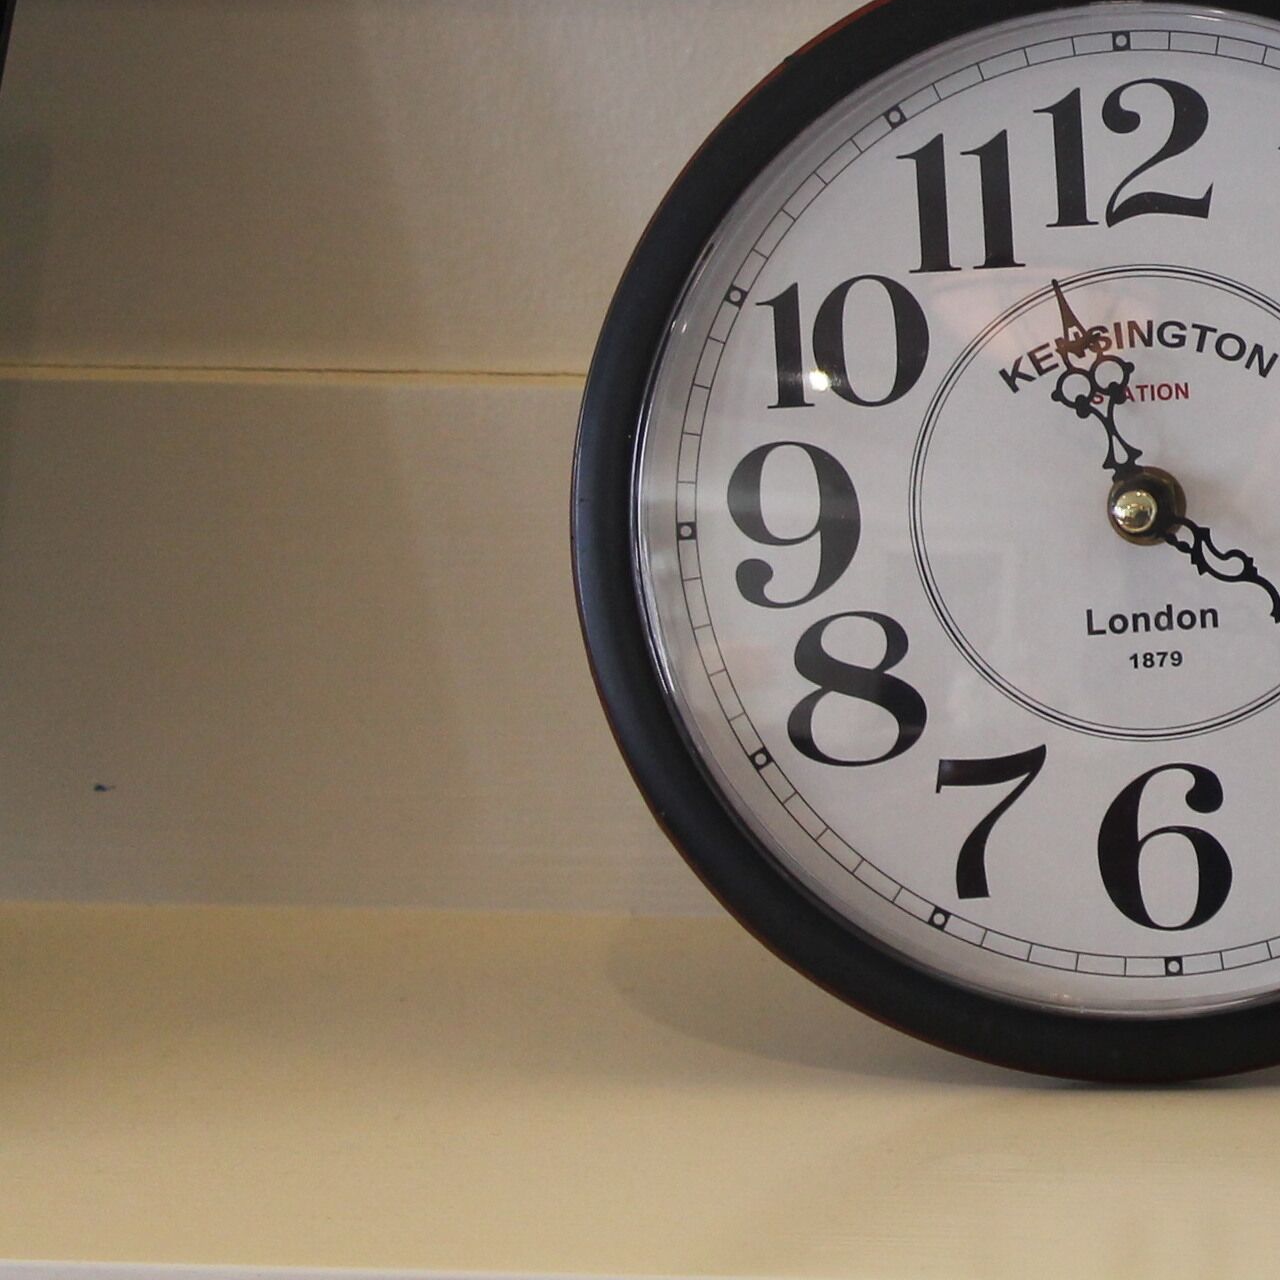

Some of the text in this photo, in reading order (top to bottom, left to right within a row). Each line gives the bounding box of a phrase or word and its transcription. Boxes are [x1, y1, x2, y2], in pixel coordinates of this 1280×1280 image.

[896, 129, 1025, 273] 11
[1033, 78, 1213, 228] 12
[756, 275, 929, 409] 10
[1092, 382, 1190, 405] SATION
[728, 442, 860, 608] 9
[787, 611, 927, 767] 8
[1087, 604, 1218, 635] London
[1130, 651, 1182, 668] 1879
[936, 744, 1046, 899] 7
[1098, 763, 1232, 931] 6
